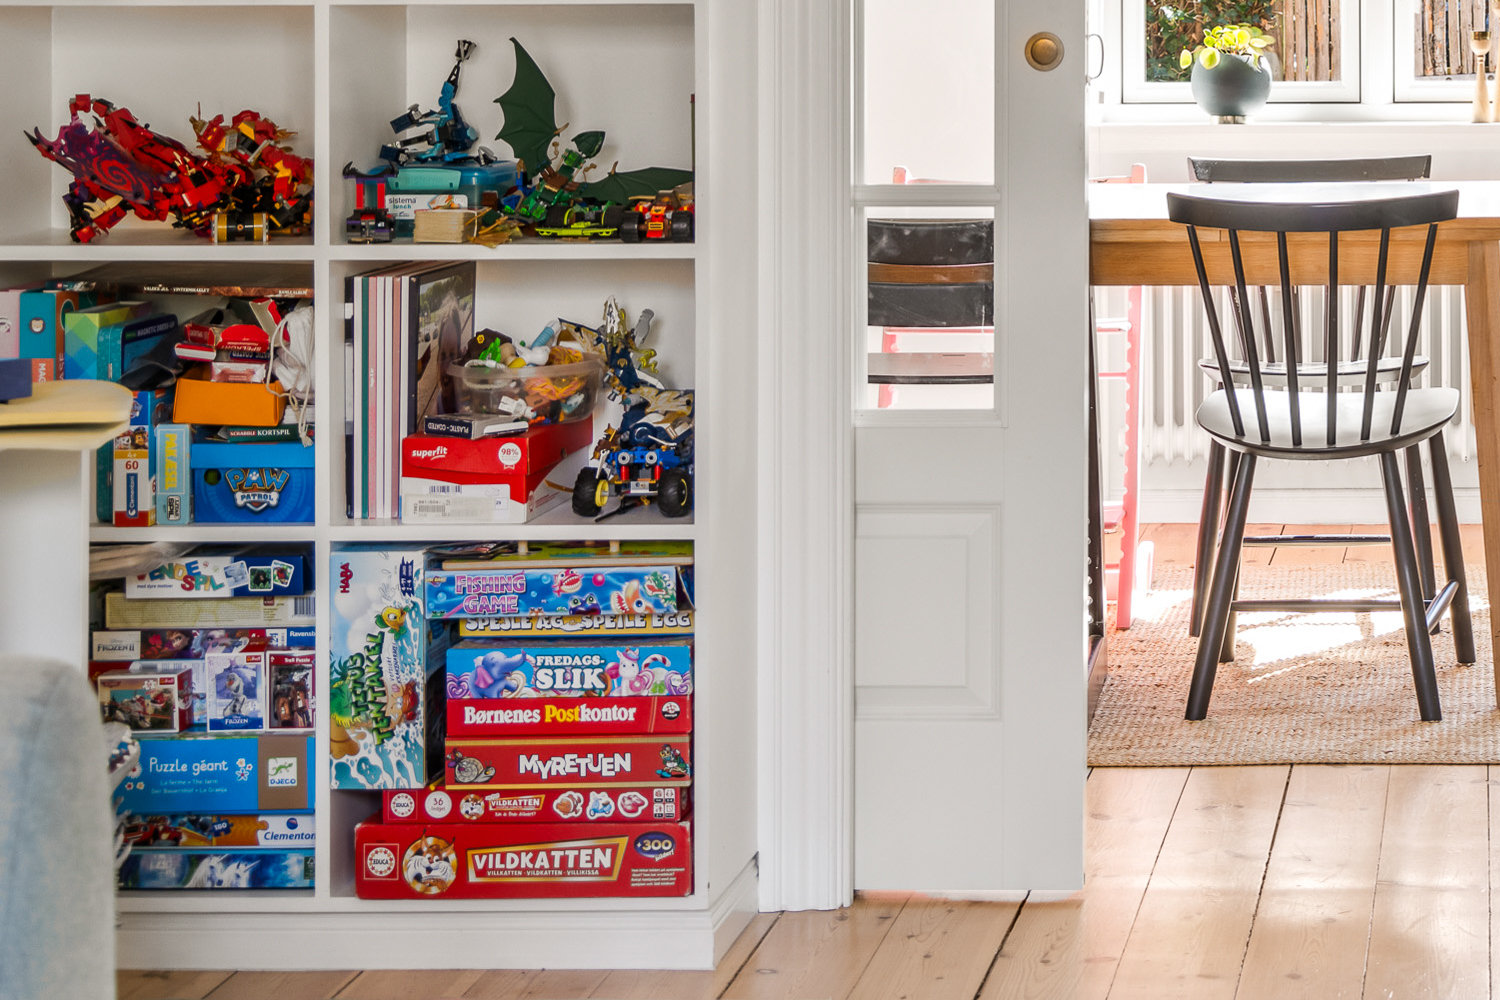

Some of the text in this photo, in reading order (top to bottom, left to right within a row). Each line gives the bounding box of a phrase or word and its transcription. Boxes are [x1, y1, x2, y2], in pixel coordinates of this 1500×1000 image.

[389, 196, 417, 205] sistema
[412, 445, 447, 459] superfit
[501, 448, 519, 457] 98%
[125, 461, 138, 469] 60
[225, 468, 289, 492] PAW
[237, 493, 274, 502] PATROL
[340, 563, 353, 593] HABA
[454, 574, 526, 595] FISHING
[463, 596, 518, 613] GAME
[536, 656, 605, 667] FREDAGS-
[348, 653, 366, 716] TITUS
[364, 631, 394, 745] TENTAKEL
[535, 668, 605, 691] SLIK
[225, 717, 248, 725] FROZEN
[464, 705, 636, 723] Børnenes Postkontor
[150, 758, 227, 775] Puzzle géant
[519, 753, 631, 779] MYRETUEN
[491, 798, 541, 807] VILDKATTEN
[636, 839, 673, 853] +300
[474, 847, 611, 870] VILDKATTEN
